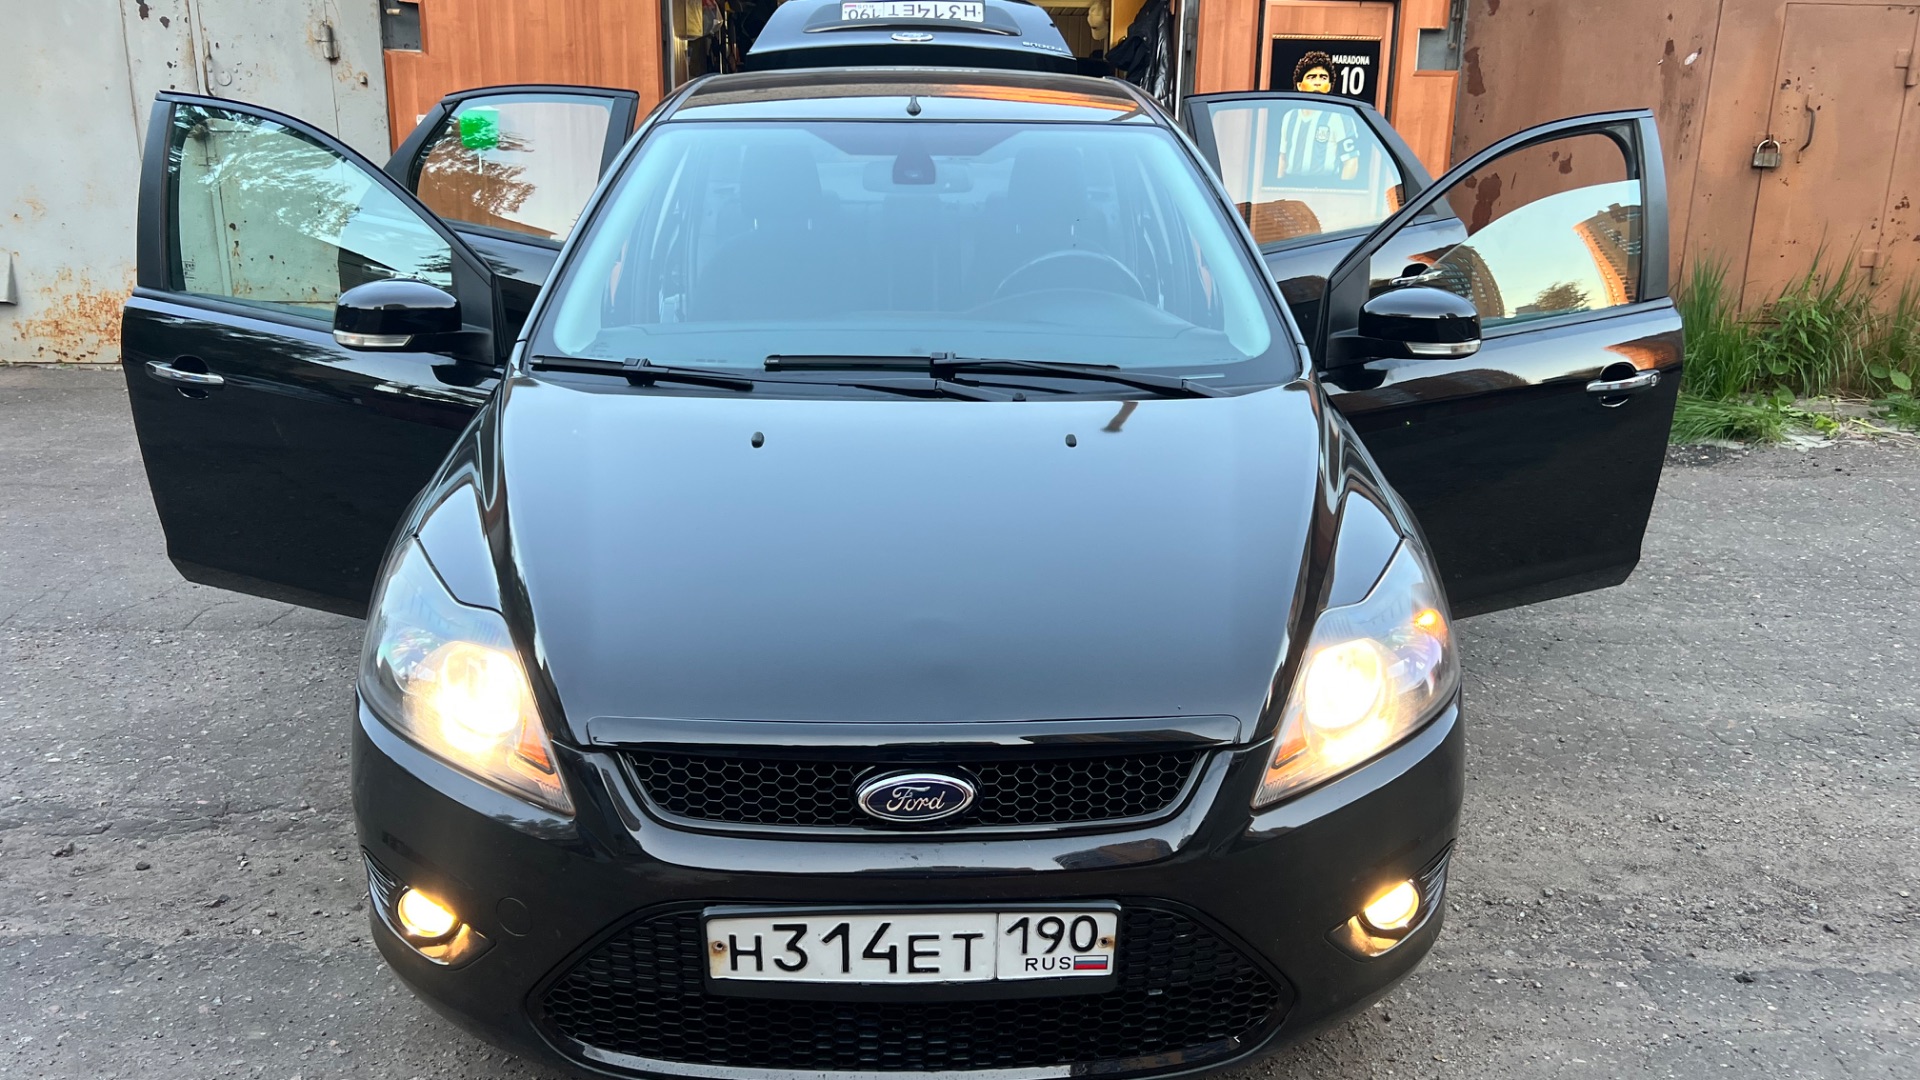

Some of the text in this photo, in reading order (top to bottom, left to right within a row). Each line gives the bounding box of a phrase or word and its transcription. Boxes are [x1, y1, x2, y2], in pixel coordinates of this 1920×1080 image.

[1332, 55, 1370, 65] MARADONA
[1341, 66, 1365, 95] 10
[886, 786, 946, 811] Ford
[1005, 915, 1099, 955] 190
[1025, 956, 1071, 972] RUS
